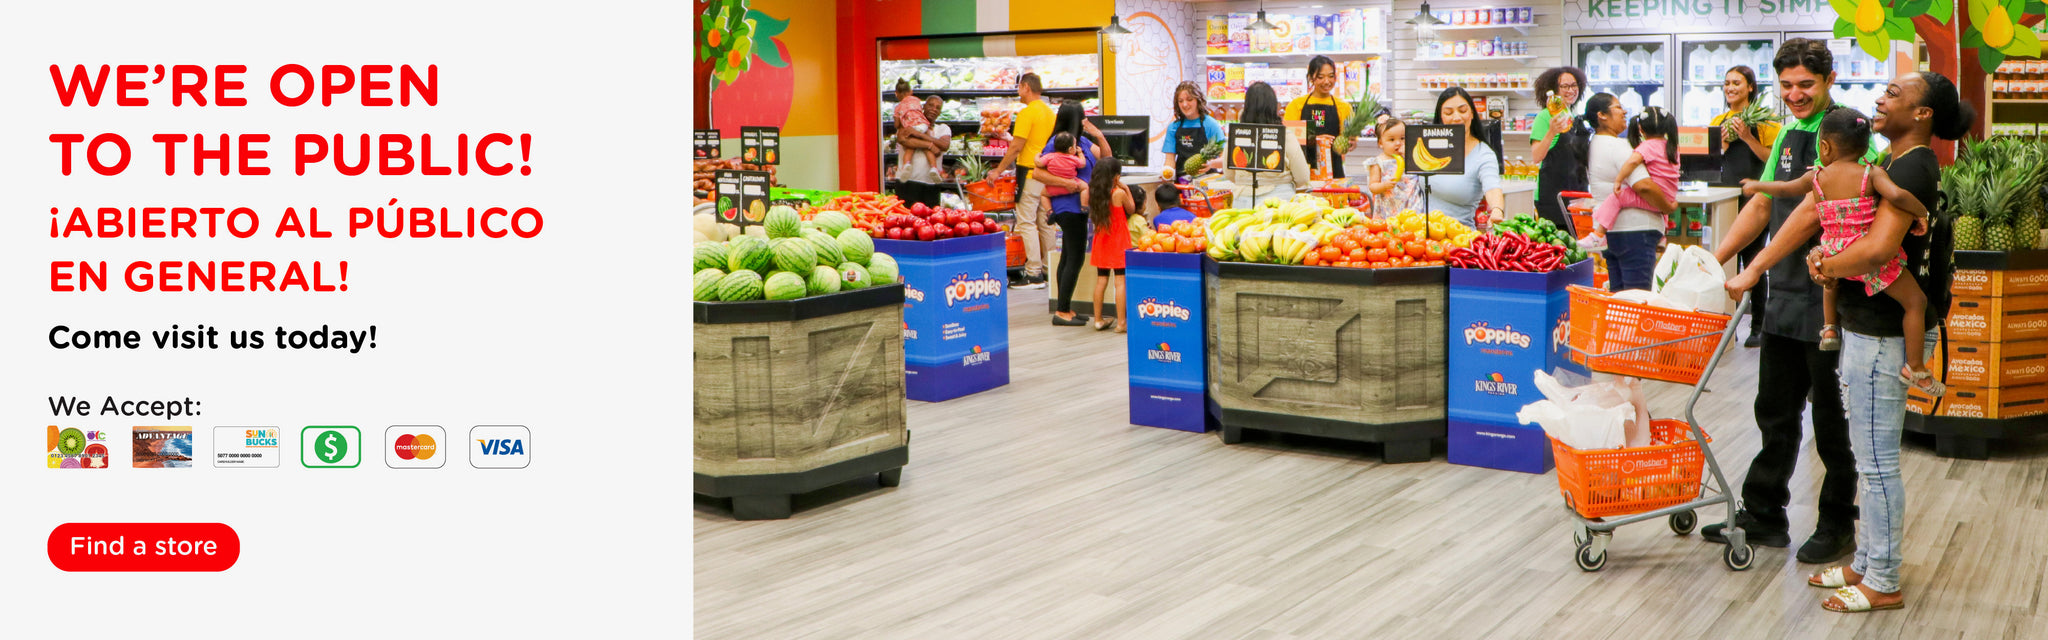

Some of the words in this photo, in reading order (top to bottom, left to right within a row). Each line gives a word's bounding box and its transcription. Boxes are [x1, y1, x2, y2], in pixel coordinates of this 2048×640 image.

[1589, 0, 1712, 18] KEEPING
[1423, 128, 1454, 137] BANANAS
[945, 272, 1002, 307] poppies
[1138, 300, 1190, 321] poppies
[1952, 313, 1985, 321] Avocados
[1655, 320, 1687, 332] Mother's
[1950, 320, 1987, 329] Mexico
[2008, 321, 2027, 329] ALWAYS
[2028, 320, 2047, 329] GOOD
[1464, 325, 1531, 349] poppies
[1148, 349, 1165, 360] KINGS
[1165, 351, 1181, 363] RIVER
[1480, 348, 1513, 356] mandarins
[1951, 358, 1983, 366] Avocados
[1948, 365, 1985, 374] Mexico
[2025, 365, 2045, 374] GOOD
[1475, 380, 1496, 392] KINGS
[1497, 381, 1518, 396] RIVER
[1949, 403, 1982, 411] Avocados
[1947, 409, 1984, 418] Mexico
[1636, 458, 1668, 468] Mother's
